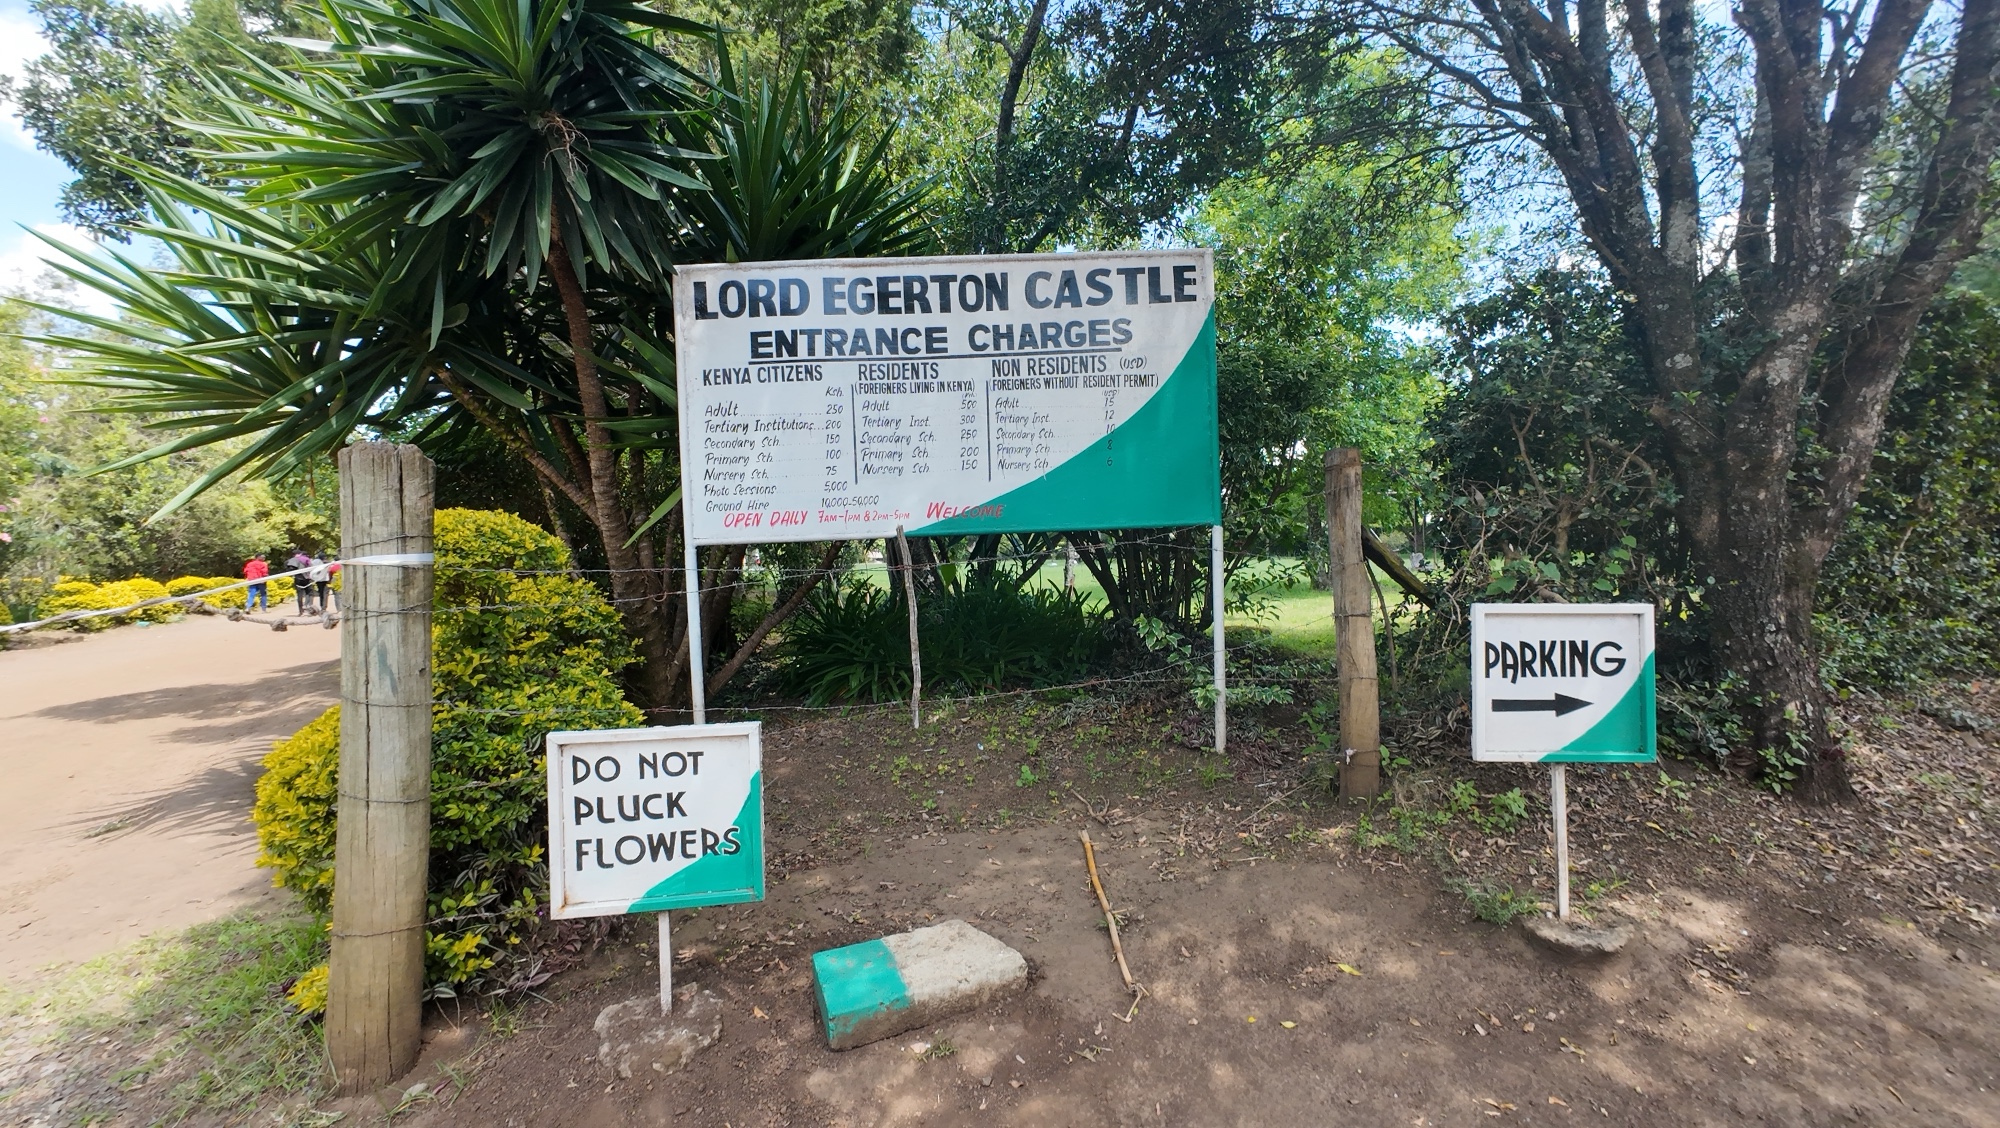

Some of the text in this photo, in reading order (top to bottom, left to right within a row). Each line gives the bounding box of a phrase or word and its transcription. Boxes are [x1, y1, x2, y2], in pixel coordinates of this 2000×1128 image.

[693, 265, 1197, 320] LORD EGERTON CASTLE
[750, 318, 1133, 359] ENTRANCE CHARGES
[858, 362, 940, 381] RESIDENTS
[991, 354, 1148, 377] NON RESIDENTS (USD)
[703, 364, 823, 386] KENYA CITIZENS
[989, 373, 1159, 392] (FOREIGNERS WITHOUT RESIDENT PERMIT)
[854, 378, 976, 395] (FOREIGNERS LIVING IN KENYA)
[705, 400, 843, 417] Adult 250
[861, 399, 977, 412] Adult 500
[995, 397, 1115, 409] Adult 15
[862, 415, 902, 430] Tertiary
[960, 414, 976, 425] 300
[995, 411, 1029, 426] Tertiary
[1105, 410, 1115, 420] 12
[705, 420, 749, 435] Tertiary
[825, 420, 842, 430] 200
[996, 427, 1035, 441] Secondary
[704, 437, 756, 451] Secondary
[826, 434, 840, 444] 150
[859, 431, 911, 445] Secondary
[960, 429, 978, 440] 250
[860, 447, 903, 461] Primary
[960, 446, 979, 458] 200
[996, 443, 1031, 457] Primary
[1107, 439, 1113, 450] 8
[705, 453, 750, 466] Primary
[825, 449, 841, 459] 100
[998, 458, 1031, 471] Nursery
[1107, 457, 1113, 467] 6
[703, 468, 745, 482] Nursery
[825, 465, 838, 476] 75
[862, 463, 904, 476] Nursery
[961, 459, 978, 471] 150
[703, 481, 848, 496] Photo Sessions 5,000
[705, 500, 743, 512] Ground
[747, 499, 770, 511] Hire
[723, 512, 764, 528] OPEN
[769, 510, 808, 527] DAILY
[863, 510, 870, 522] &
[1484, 639, 1627, 685] PARKING
[572, 751, 704, 785] DO NOT
[574, 791, 688, 826] PLUCK
[575, 827, 741, 871] FLOWERS
